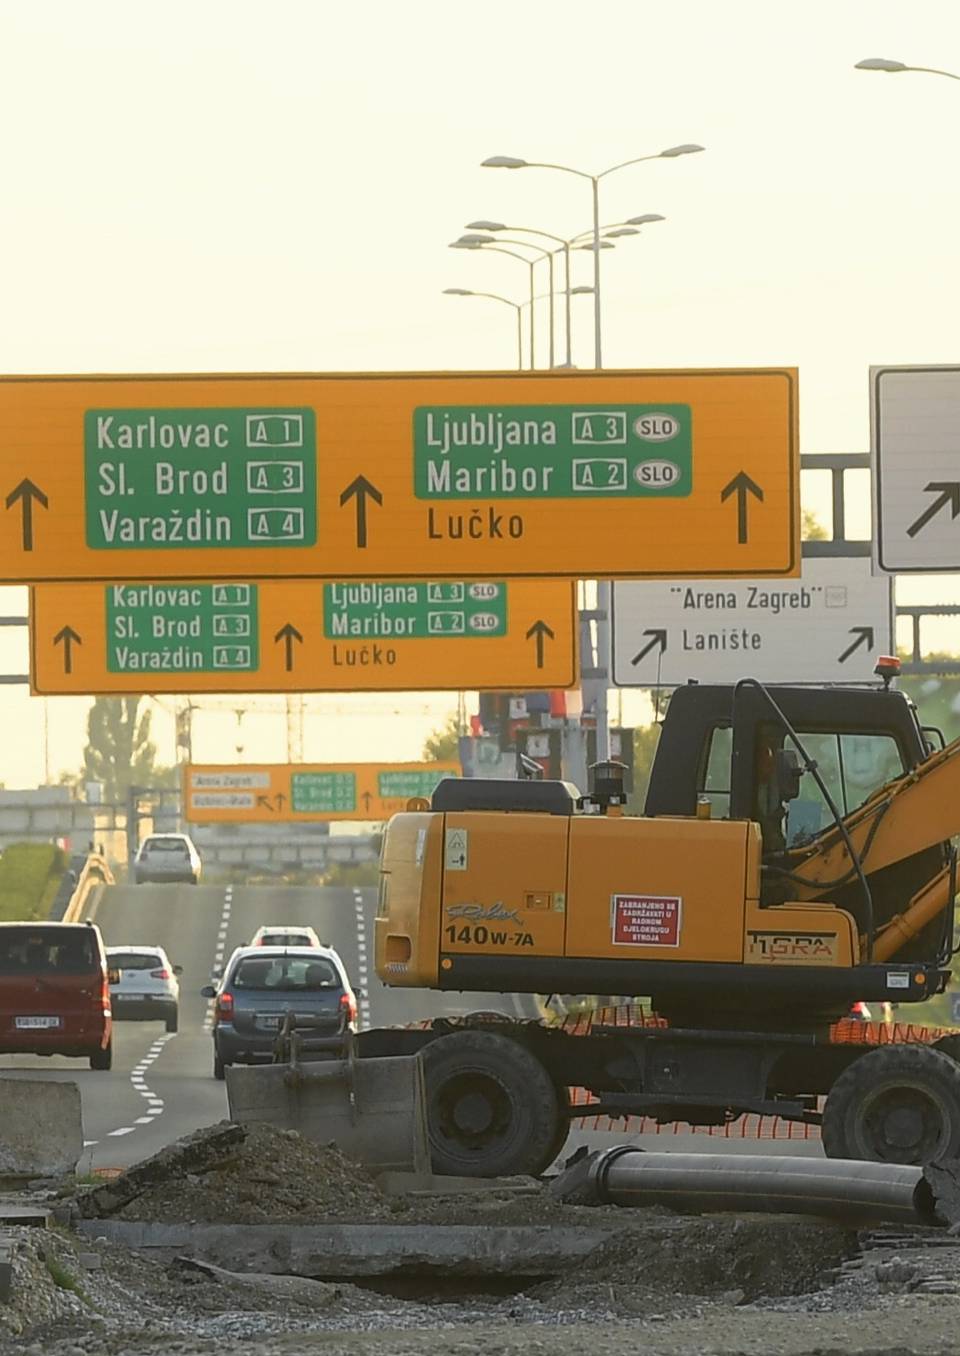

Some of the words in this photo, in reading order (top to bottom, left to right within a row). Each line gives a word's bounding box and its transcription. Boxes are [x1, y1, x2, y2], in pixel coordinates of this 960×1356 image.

[98, 416, 229, 448] Karlovac
[427, 413, 556, 454] Ljubljana
[640, 419, 673, 436] SLO
[99, 462, 135, 496] Sl.
[156, 461, 227, 495] Brod
[427, 459, 553, 492] Maribor
[641, 466, 673, 483] SLO
[100, 508, 231, 542] Varaždin
[428, 507, 524, 539] Lučko
[113, 585, 202, 607] Karlovac
[331, 583, 417, 609] Ljubljana
[474, 586, 495, 597] SLO
[115, 615, 139, 638] Sl.
[153, 615, 200, 637] Brod
[332, 612, 416, 635] Maribor
[474, 617, 495, 627] SLO
[683, 629, 761, 650] Lanište
[115, 646, 203, 669] Varaždin
[333, 644, 396, 665] Lučko
